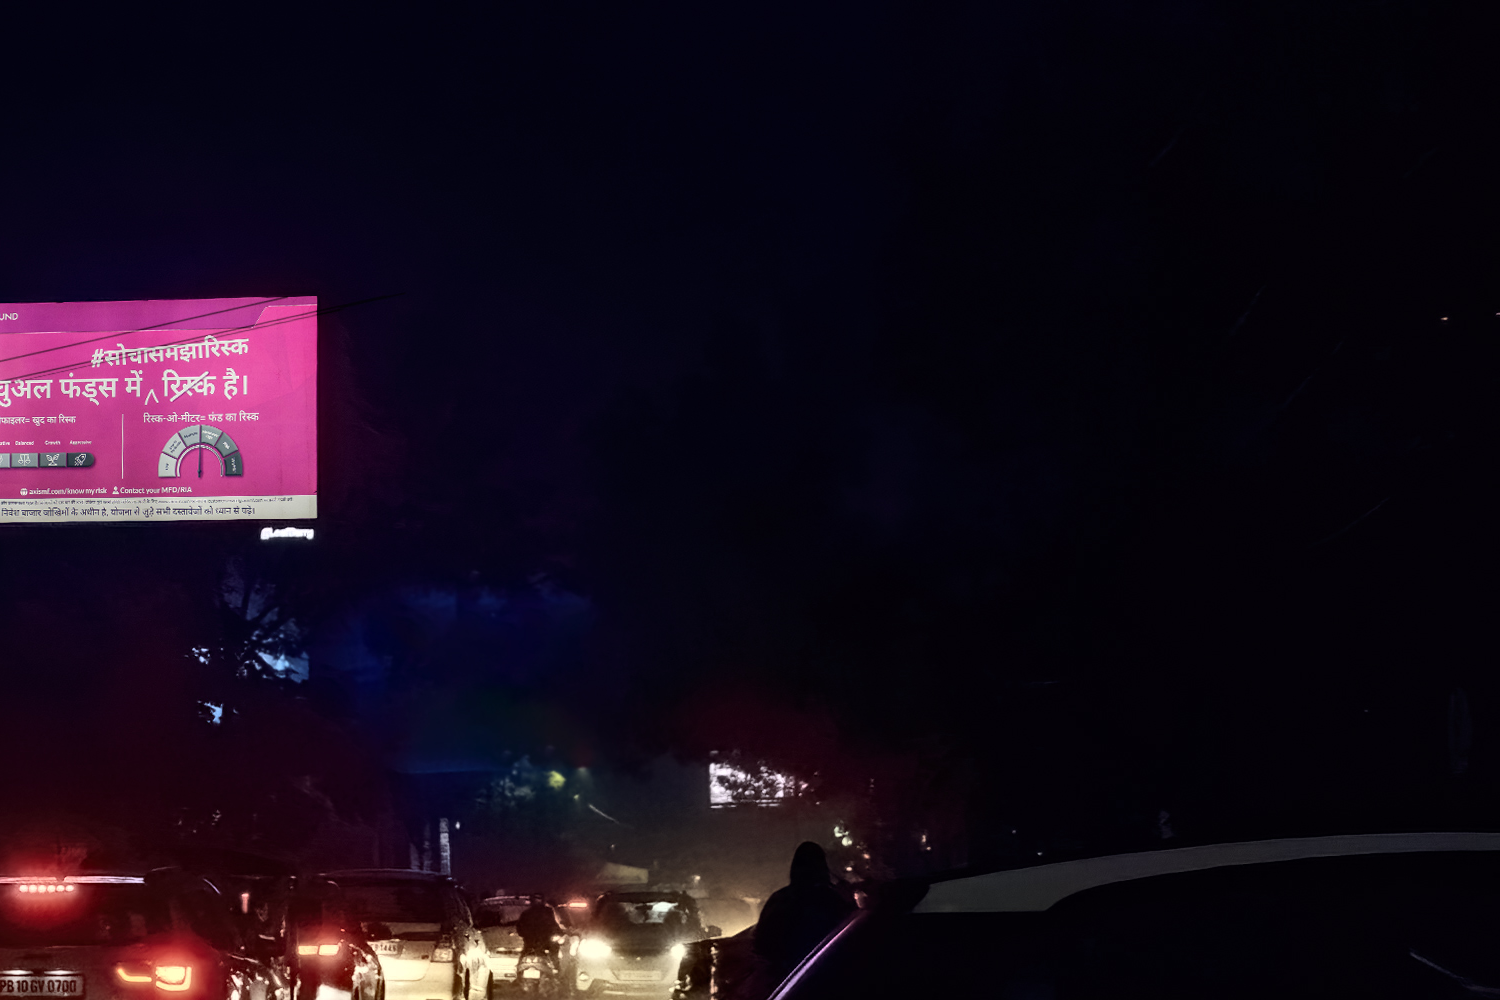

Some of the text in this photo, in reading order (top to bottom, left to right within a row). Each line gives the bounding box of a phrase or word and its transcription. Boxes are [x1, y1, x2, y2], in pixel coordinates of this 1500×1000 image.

[59, 372, 119, 406] फंड्स
[124, 370, 143, 397] में
[162, 368, 217, 402] रिस्क
[32, 415, 45, 427] खुद
[47, 415, 57, 425] का
[58, 413, 76, 424] रिस्क
[208, 411, 224, 422] फंड
[225, 412, 237, 422] का
[239, 410, 260, 422] रिस्क
[120, 486, 193, 496] Contact your MFD/RIA
[0, 979, 77, 993] PB 10 GV 0700
